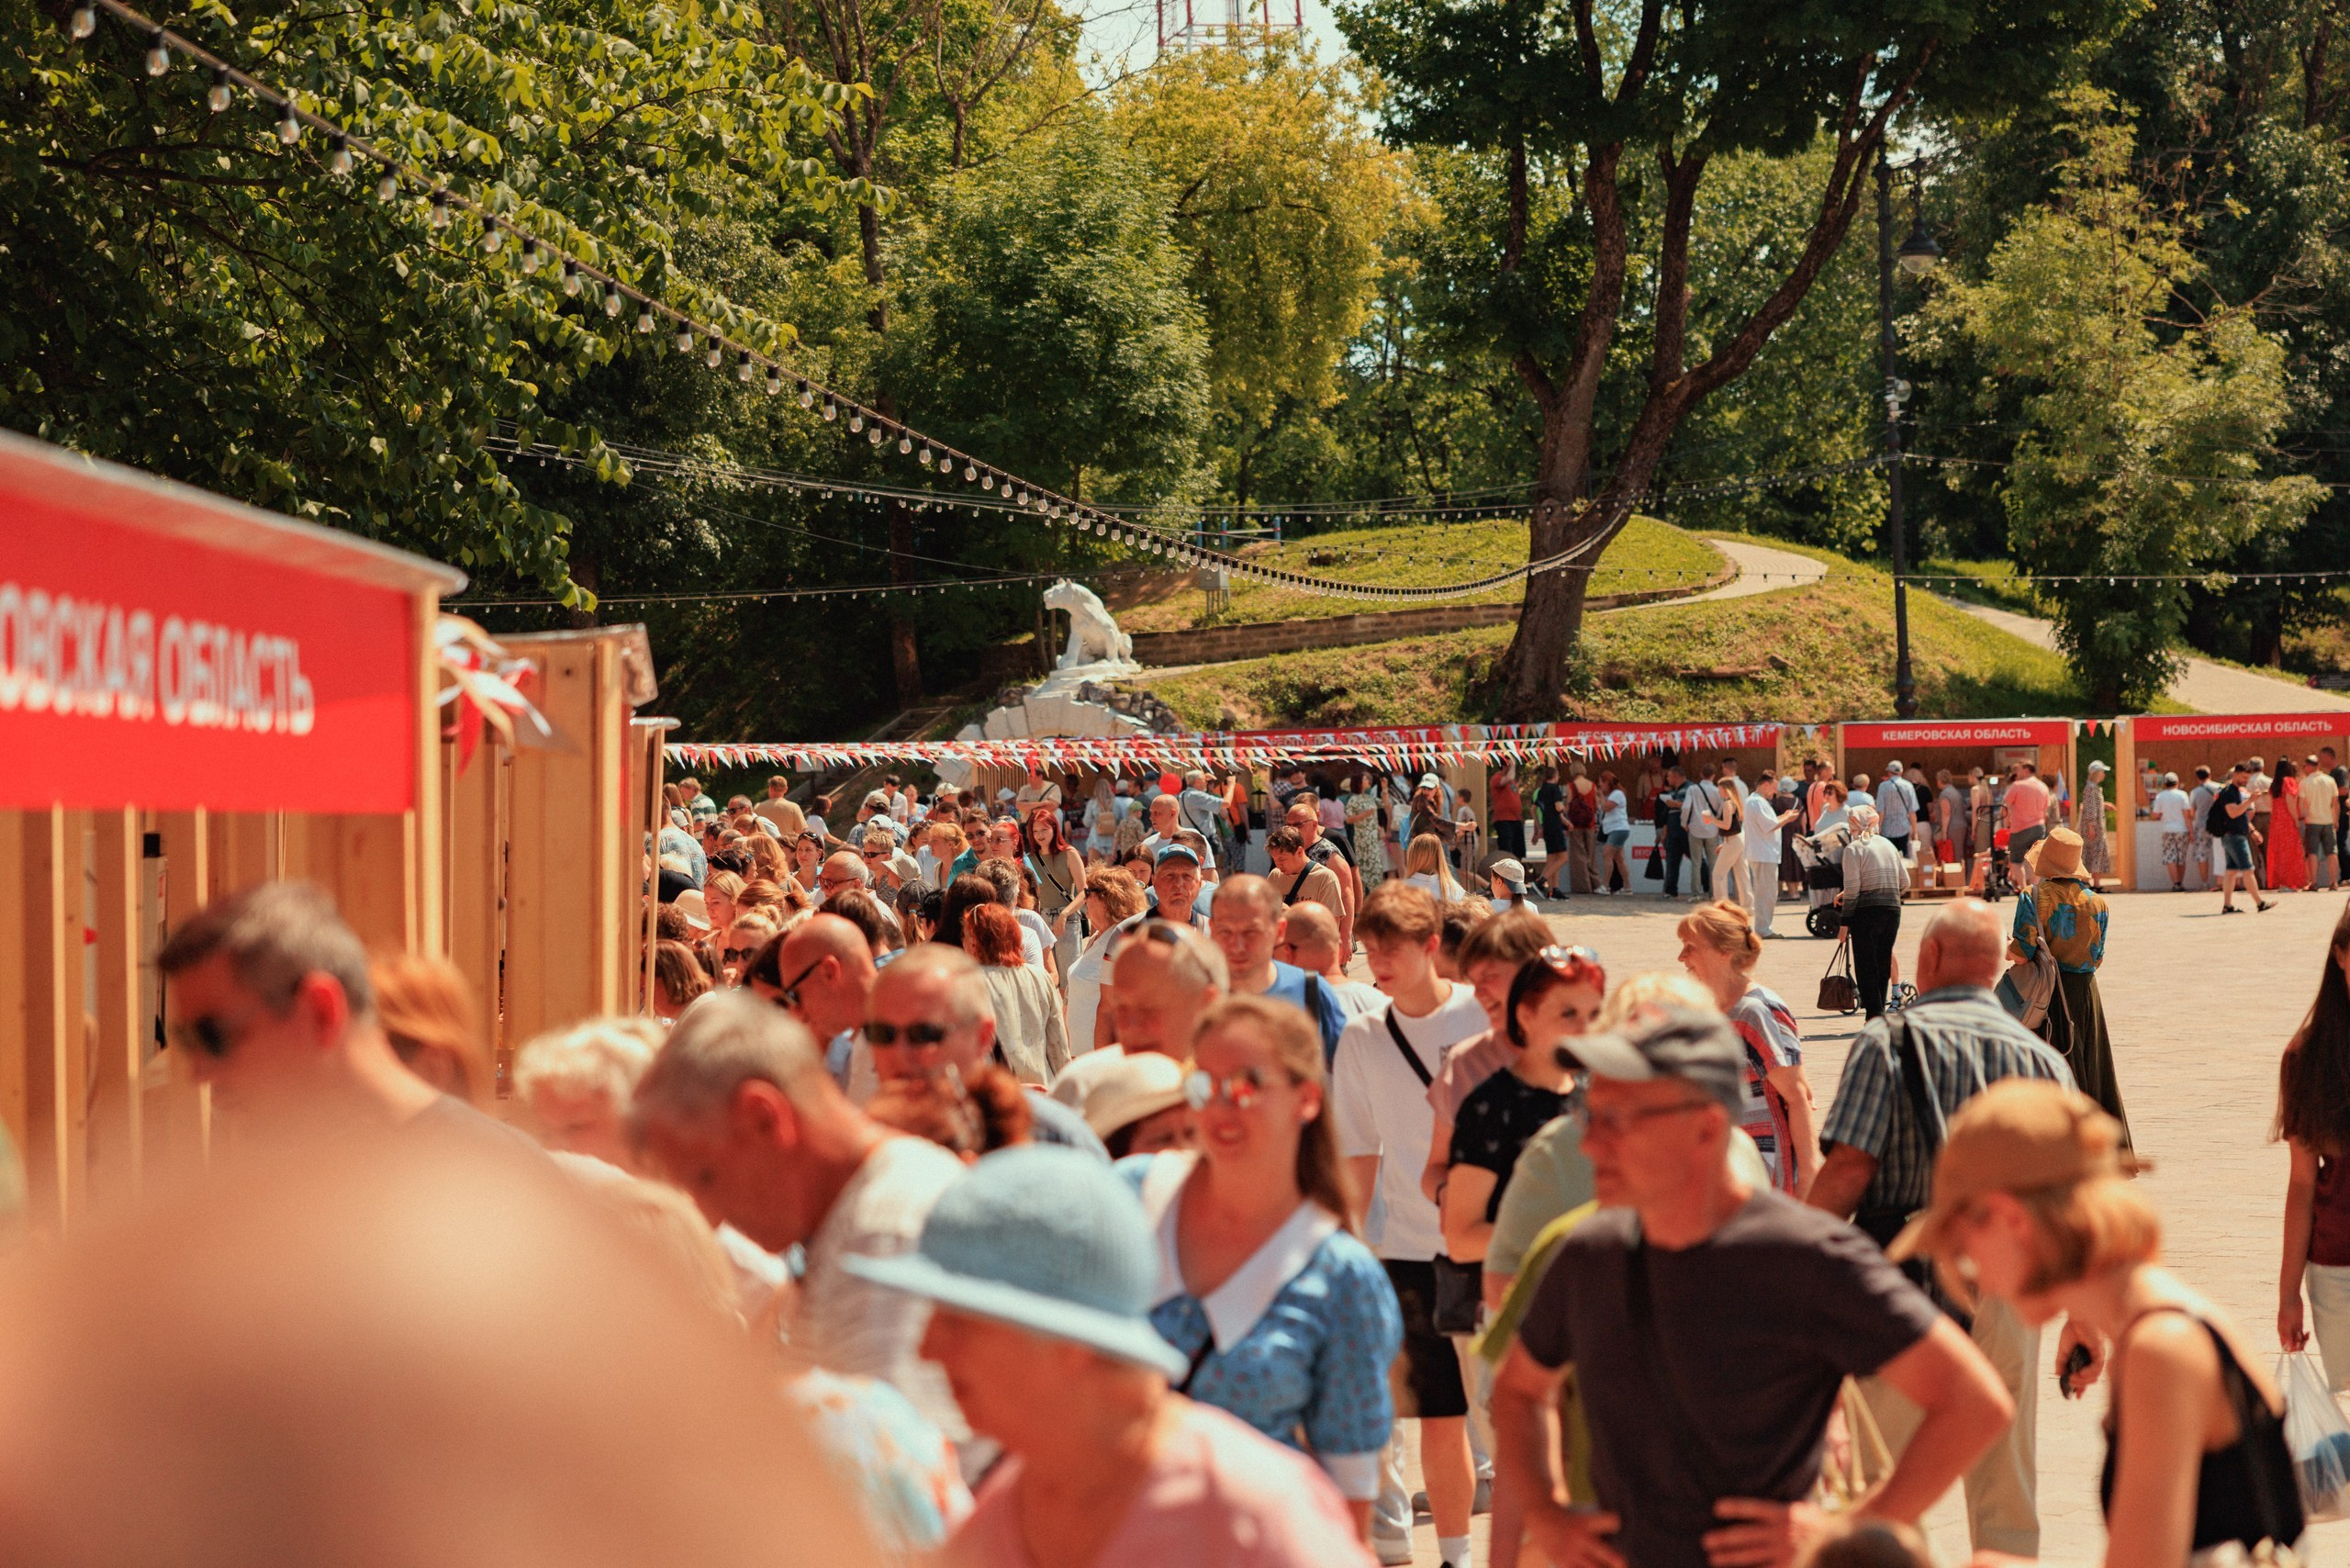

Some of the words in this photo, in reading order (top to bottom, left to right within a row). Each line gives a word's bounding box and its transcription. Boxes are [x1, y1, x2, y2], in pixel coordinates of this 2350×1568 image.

[159, 613, 315, 736] ОБЛАСТЬ
[1883, 730, 1971, 741] КЕМЕРОВСКАЯ
[1974, 729, 2031, 740] ОБЛАСТЬ
[2162, 722, 2271, 735] НОВОСИБИРСКАЯ
[2274, 721, 2333, 733] ОБЛАСТЬ
